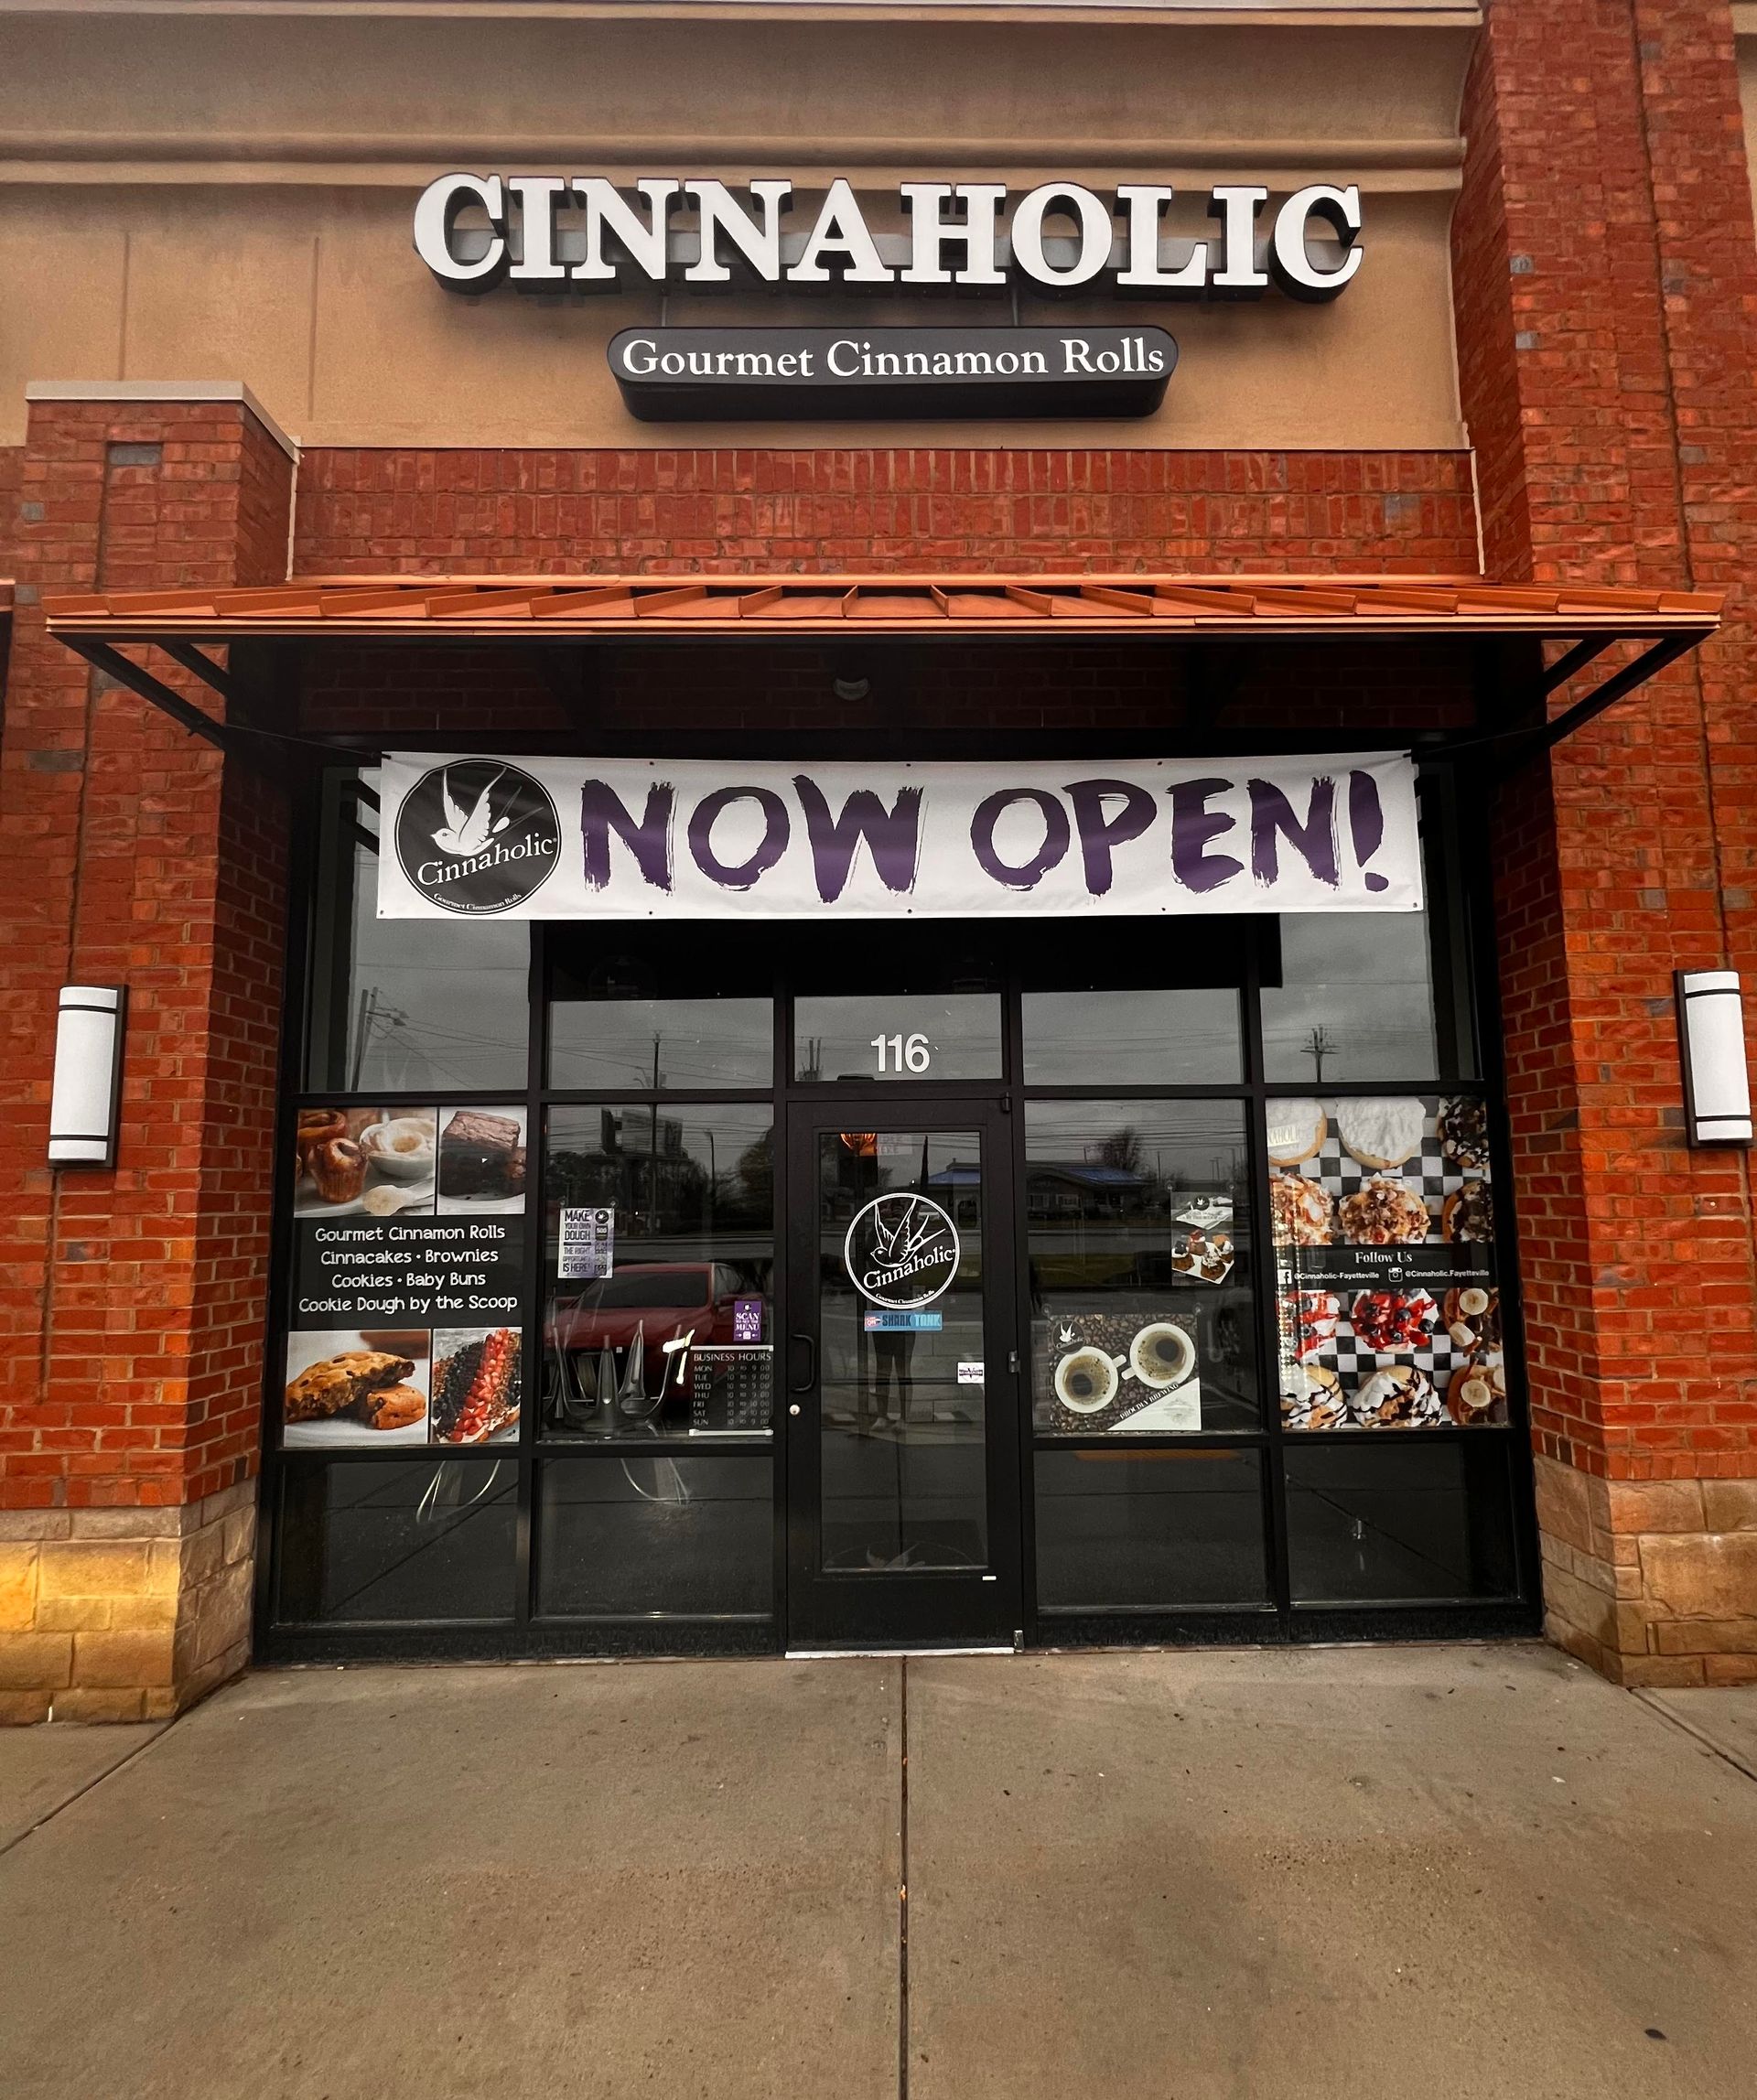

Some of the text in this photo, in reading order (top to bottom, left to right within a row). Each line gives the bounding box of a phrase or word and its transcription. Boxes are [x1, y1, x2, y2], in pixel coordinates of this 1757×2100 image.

[414, 171, 1364, 291] CINNAHOLIC
[622, 337, 1164, 377] Gourmet Cinnamon Rolls
[580, 770, 1389, 904] NOW OPEN!
[417, 833, 554, 885] Cinnaholic
[434, 893, 523, 910] Gourmet Cinnamon Rolls
[870, 1034, 931, 1072] 116
[565, 1210, 590, 1222] MAKE
[316, 1225, 505, 1242] Gourmet Cinnamon Rolls
[565, 1231, 590, 1240] DOUGH
[320, 1249, 499, 1265] Cinnacakes Brownies
[1354, 1251, 1413, 1264] Follow Us
[863, 1245, 953, 1289] Cinnaholic
[331, 1272, 486, 1290] Cookies Baby Buns
[298, 1295, 518, 1315] Cookie Dough by the Scoop
[882, 1315, 911, 1327] SHARK
[914, 1314, 941, 1327] TANK
[694, 1352, 771, 1362] BUSINESS HOURS
